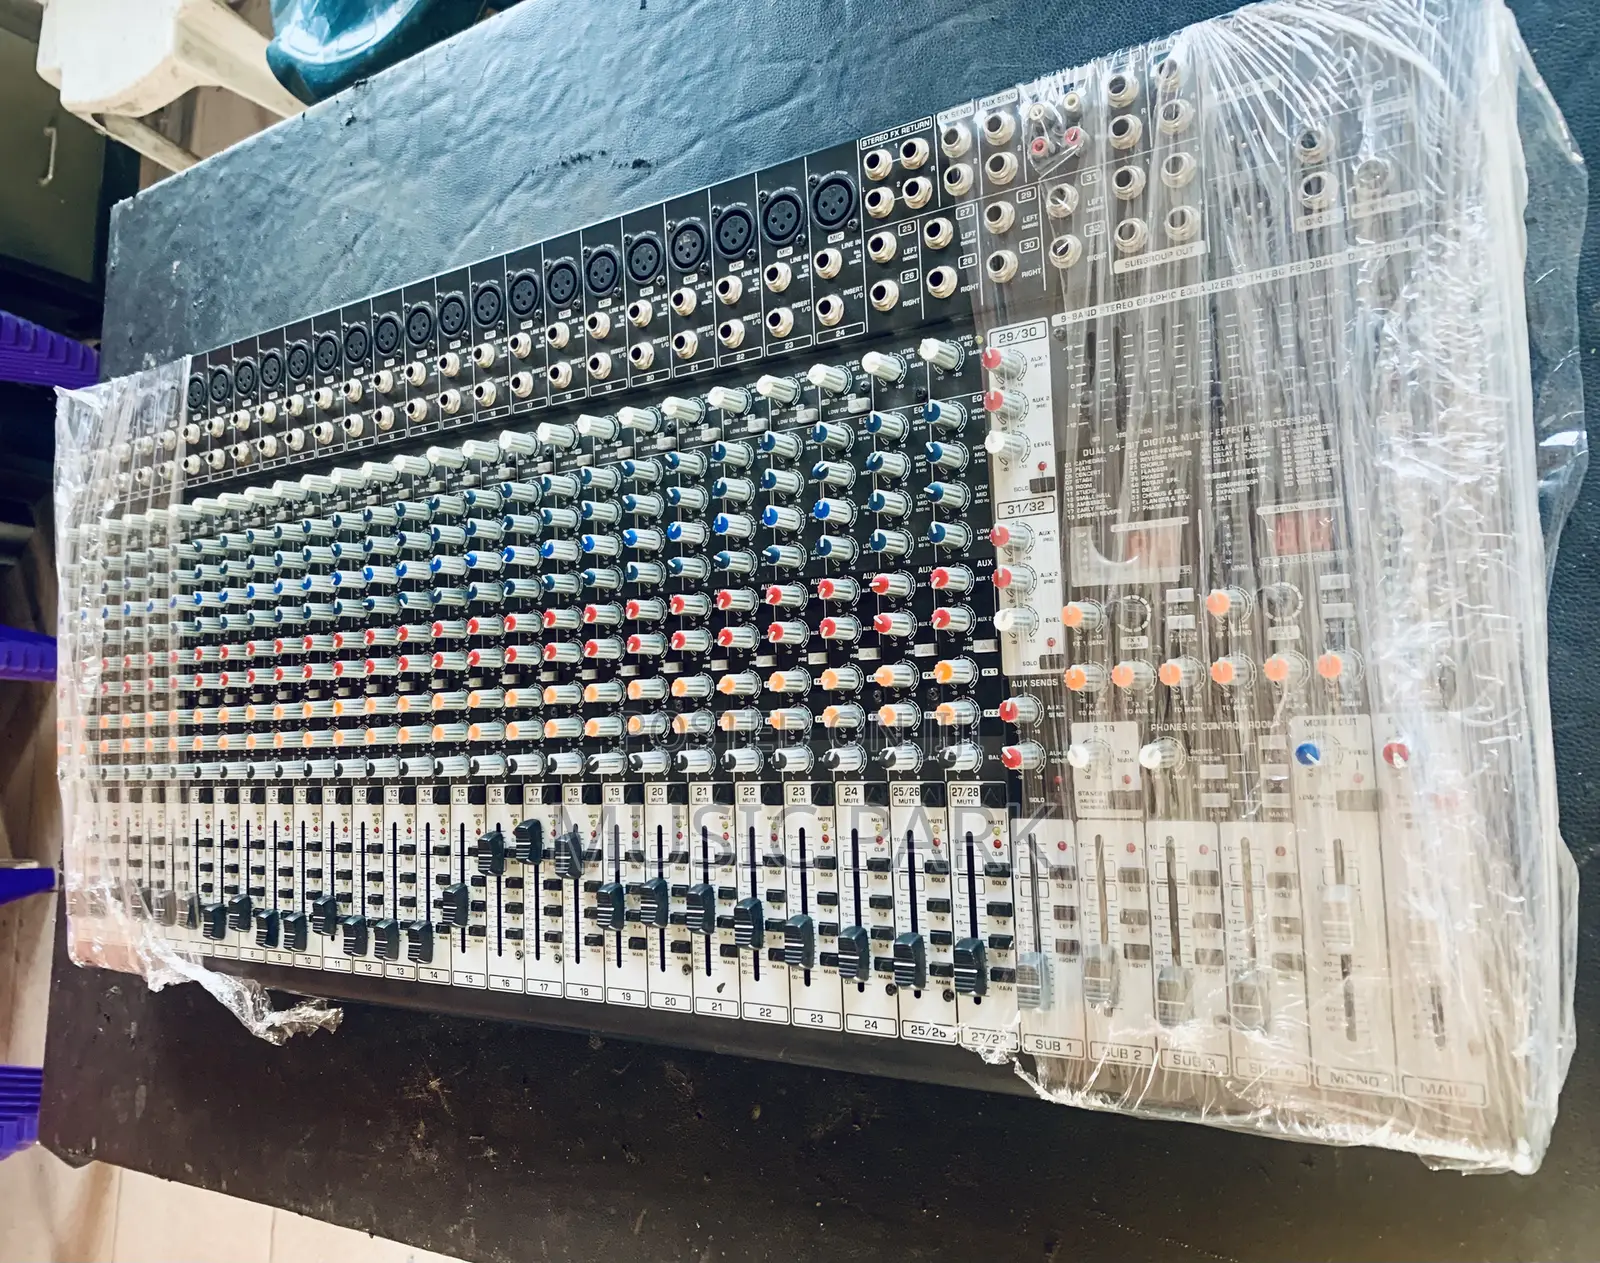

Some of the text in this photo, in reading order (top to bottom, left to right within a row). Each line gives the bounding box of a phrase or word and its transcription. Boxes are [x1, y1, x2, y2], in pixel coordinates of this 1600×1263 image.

[997, 92, 1016, 103] SEND
[951, 106, 972, 118] SEND
[862, 120, 930, 148] STEREO FX RETURN
[1021, 191, 1032, 200] 29
[960, 208, 970, 216] 27
[1022, 214, 1038, 223] LEFT
[902, 224, 912, 232] 25
[961, 231, 976, 239] LEFT
[842, 242, 855, 250] LINE
[1024, 241, 1035, 250] 30
[903, 247, 918, 255] LEFT
[790, 256, 802, 264] LINE
[962, 257, 973, 265] 28
[1124, 252, 1173, 268] SUBGROUP
[904, 272, 914, 280] 26
[1022, 268, 1042, 278] RIGHT
[843, 286, 864, 296] INSERT
[960, 283, 979, 292] RIGHT
[902, 298, 920, 308] RIGHT
[1101, 302, 1134, 314] TEREO
[836, 329, 846, 337] 24
[998, 326, 1038, 343] 29/30
[958, 335, 973, 344] LEVEL
[784, 342, 794, 350] 23
[900, 348, 915, 356] LEVEL
[1083, 448, 1106, 456] DUAL
[1109, 441, 1140, 452] 24-BIT
[1143, 436, 1178, 448] DIGITAL
[1007, 500, 1046, 514] 31/32
[918, 566, 932, 574] AUX
[1012, 678, 1058, 688] AUX SENDS
[1151, 722, 1188, 732] PHONES
[328, 789, 335, 798] 11
[358, 789, 366, 798] 12
[390, 789, 398, 798] 13
[423, 789, 431, 798] 14
[457, 788, 465, 797] 15
[493, 788, 502, 797] 16
[530, 788, 539, 797] 17
[570, 787, 578, 796] 18
[610, 787, 620, 796] 19
[652, 787, 664, 796] 20
[696, 787, 707, 796] 21
[744, 787, 756, 796] 22
[793, 787, 806, 796] 23
[844, 787, 858, 796] 24
[893, 787, 920, 798] 25/26
[952, 787, 980, 798] 27/28
[304, 956, 312, 964] 10
[334, 960, 341, 968] 11
[364, 964, 372, 972] 12
[430, 971, 438, 979] 14
[465, 974, 474, 984] 15
[502, 978, 510, 987] 16
[540, 982, 548, 992] 17
[580, 987, 588, 996] 18
[622, 992, 631, 1001] 19
[665, 996, 676, 1006] 20
[712, 1002, 722, 1012] 21
[760, 1007, 772, 1018] 22
[810, 1012, 824, 1024] 23
[864, 1019, 878, 1030] 24
[910, 1024, 946, 1038] 25/26
[1036, 1038, 1061, 1052] SUB
[1102, 1046, 1142, 1061] SUB 2
[1173, 1054, 1200, 1067] SUB
[1330, 1070, 1380, 1088] MONO
[1420, 1082, 1468, 1098] MAIN
